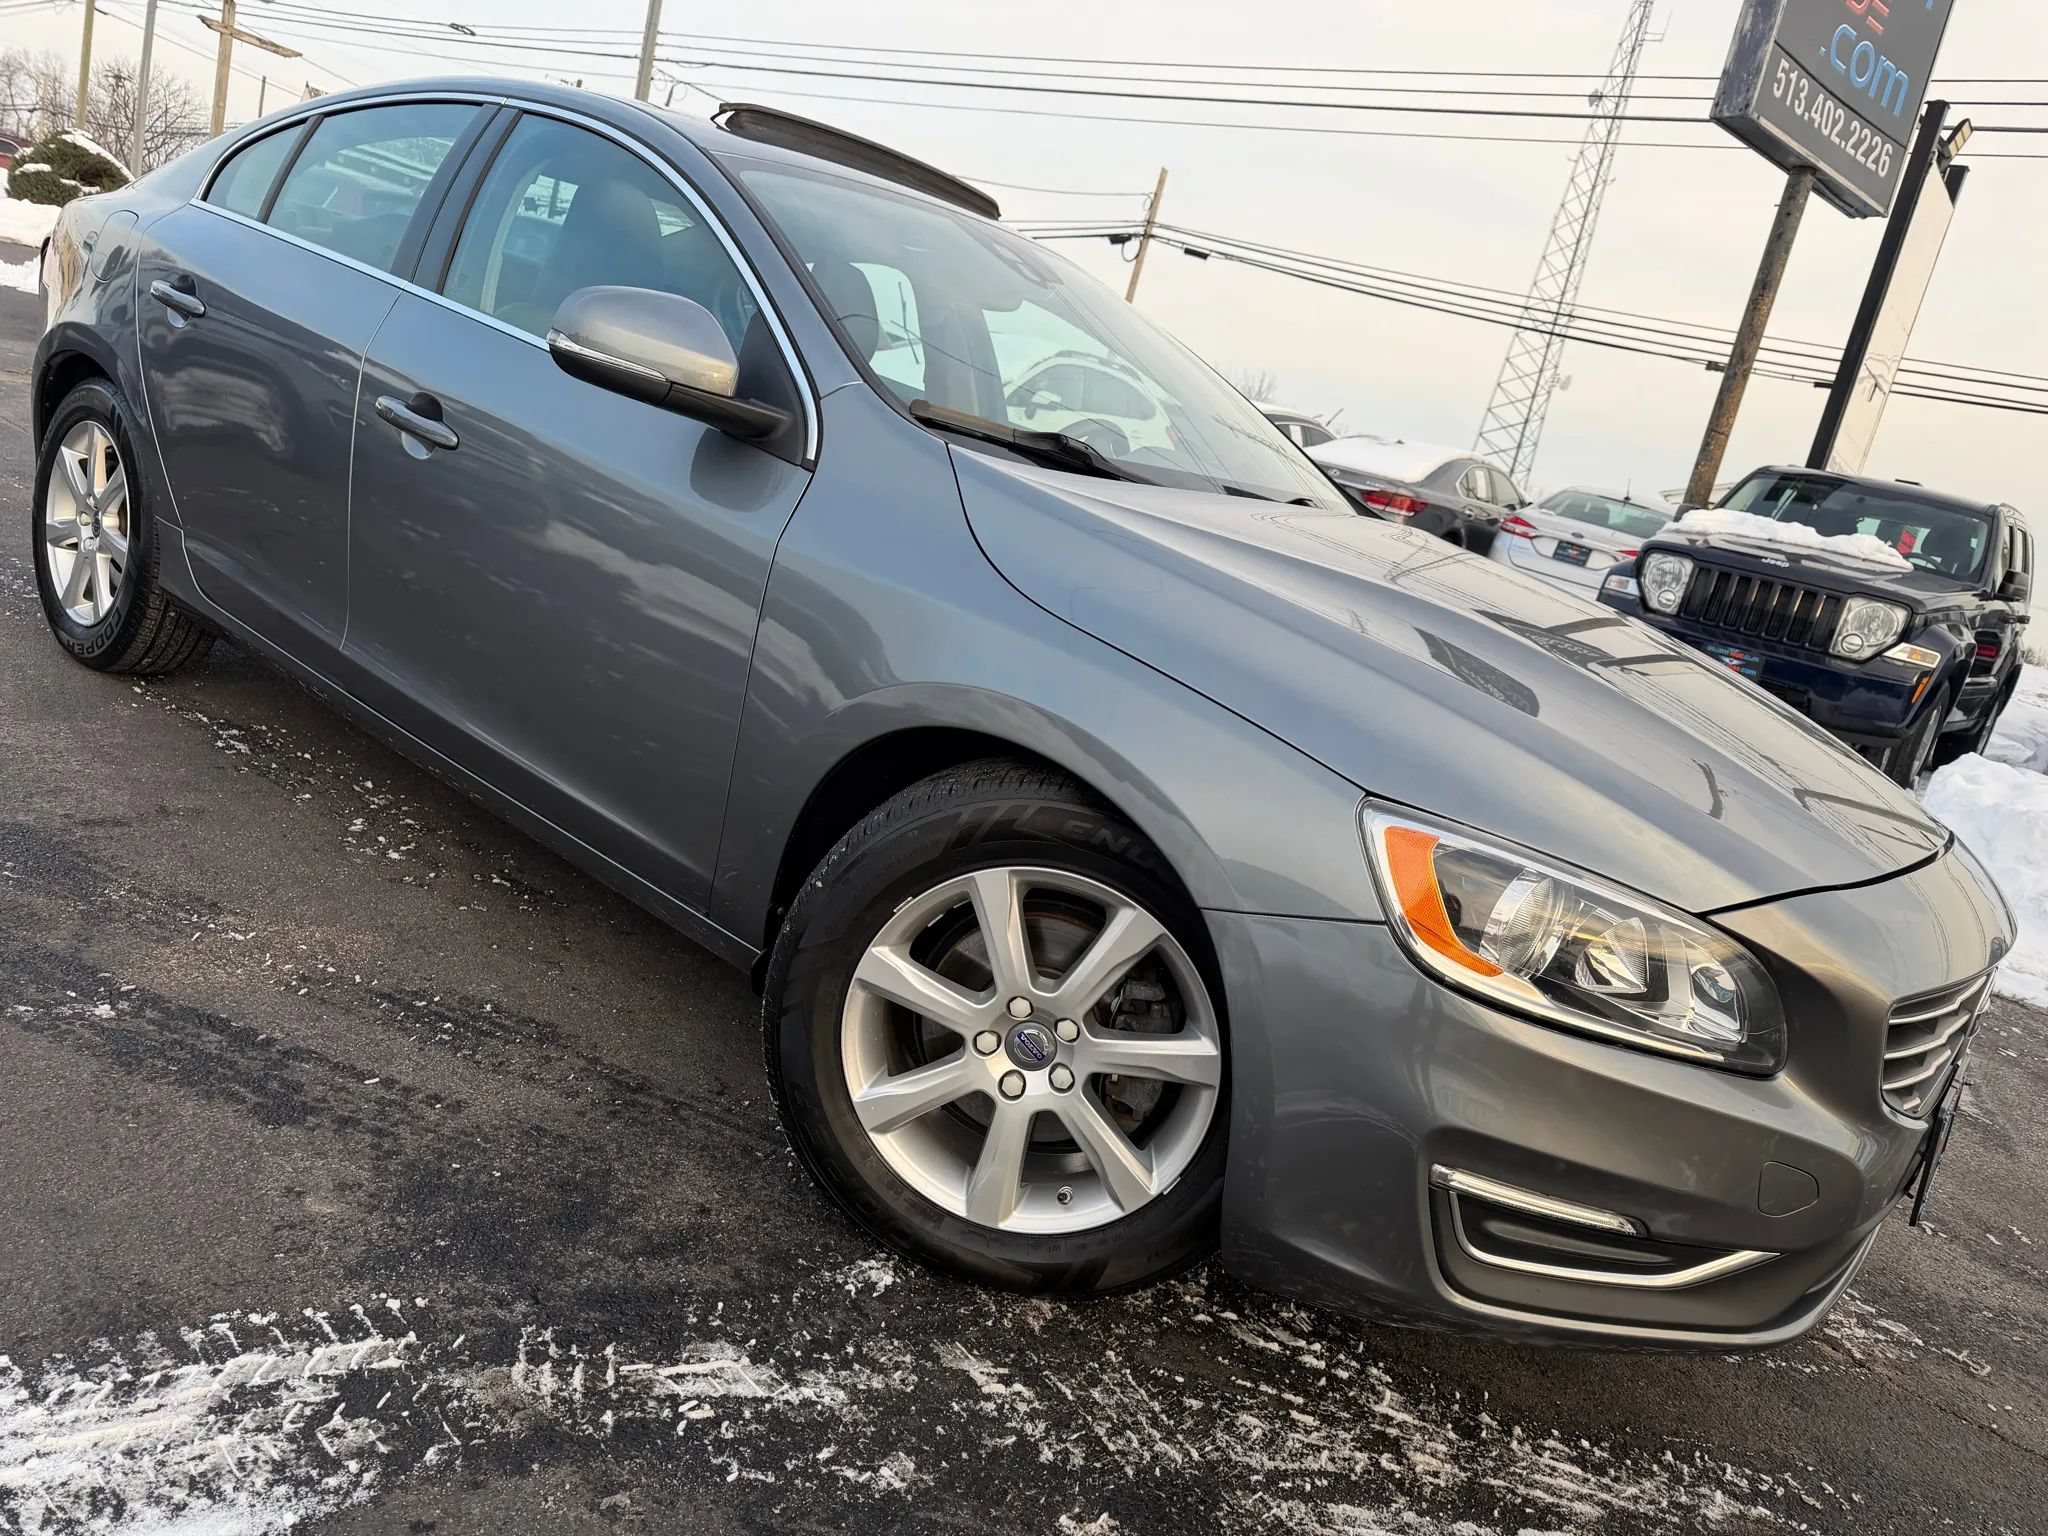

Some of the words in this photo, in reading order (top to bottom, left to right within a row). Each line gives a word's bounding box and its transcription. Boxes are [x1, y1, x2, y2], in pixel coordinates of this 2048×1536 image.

[1817, 24, 1910, 118] .com
[1773, 58, 1894, 179] 513.402.2226
[1761, 558, 1790, 568] Jeep
[67, 607, 122, 655] COOPER
[1019, 1032, 1043, 1060] VOLVO
